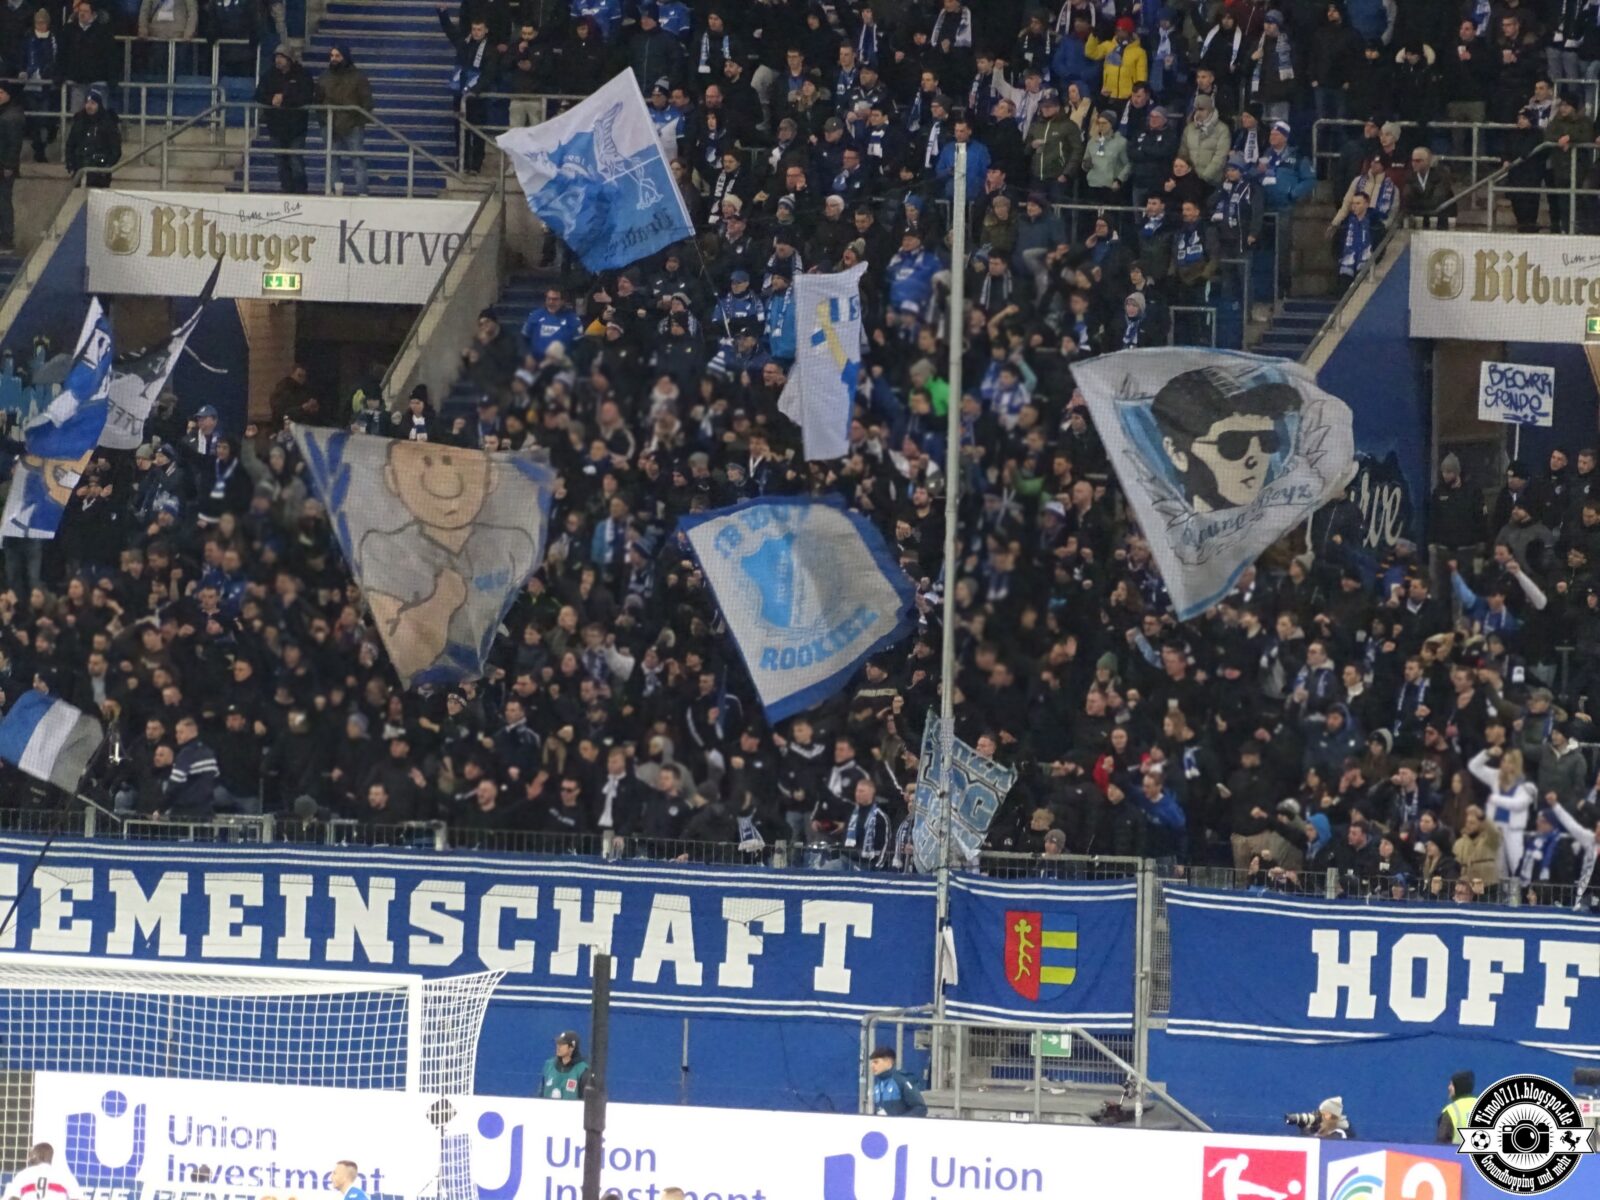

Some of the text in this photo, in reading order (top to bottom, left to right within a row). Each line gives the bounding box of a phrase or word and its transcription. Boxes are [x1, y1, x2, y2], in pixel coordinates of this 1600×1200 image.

[147, 206, 317, 270] Bitburger
[168, 1115, 277, 1150] Union
[930, 1156, 1043, 1192] Union
